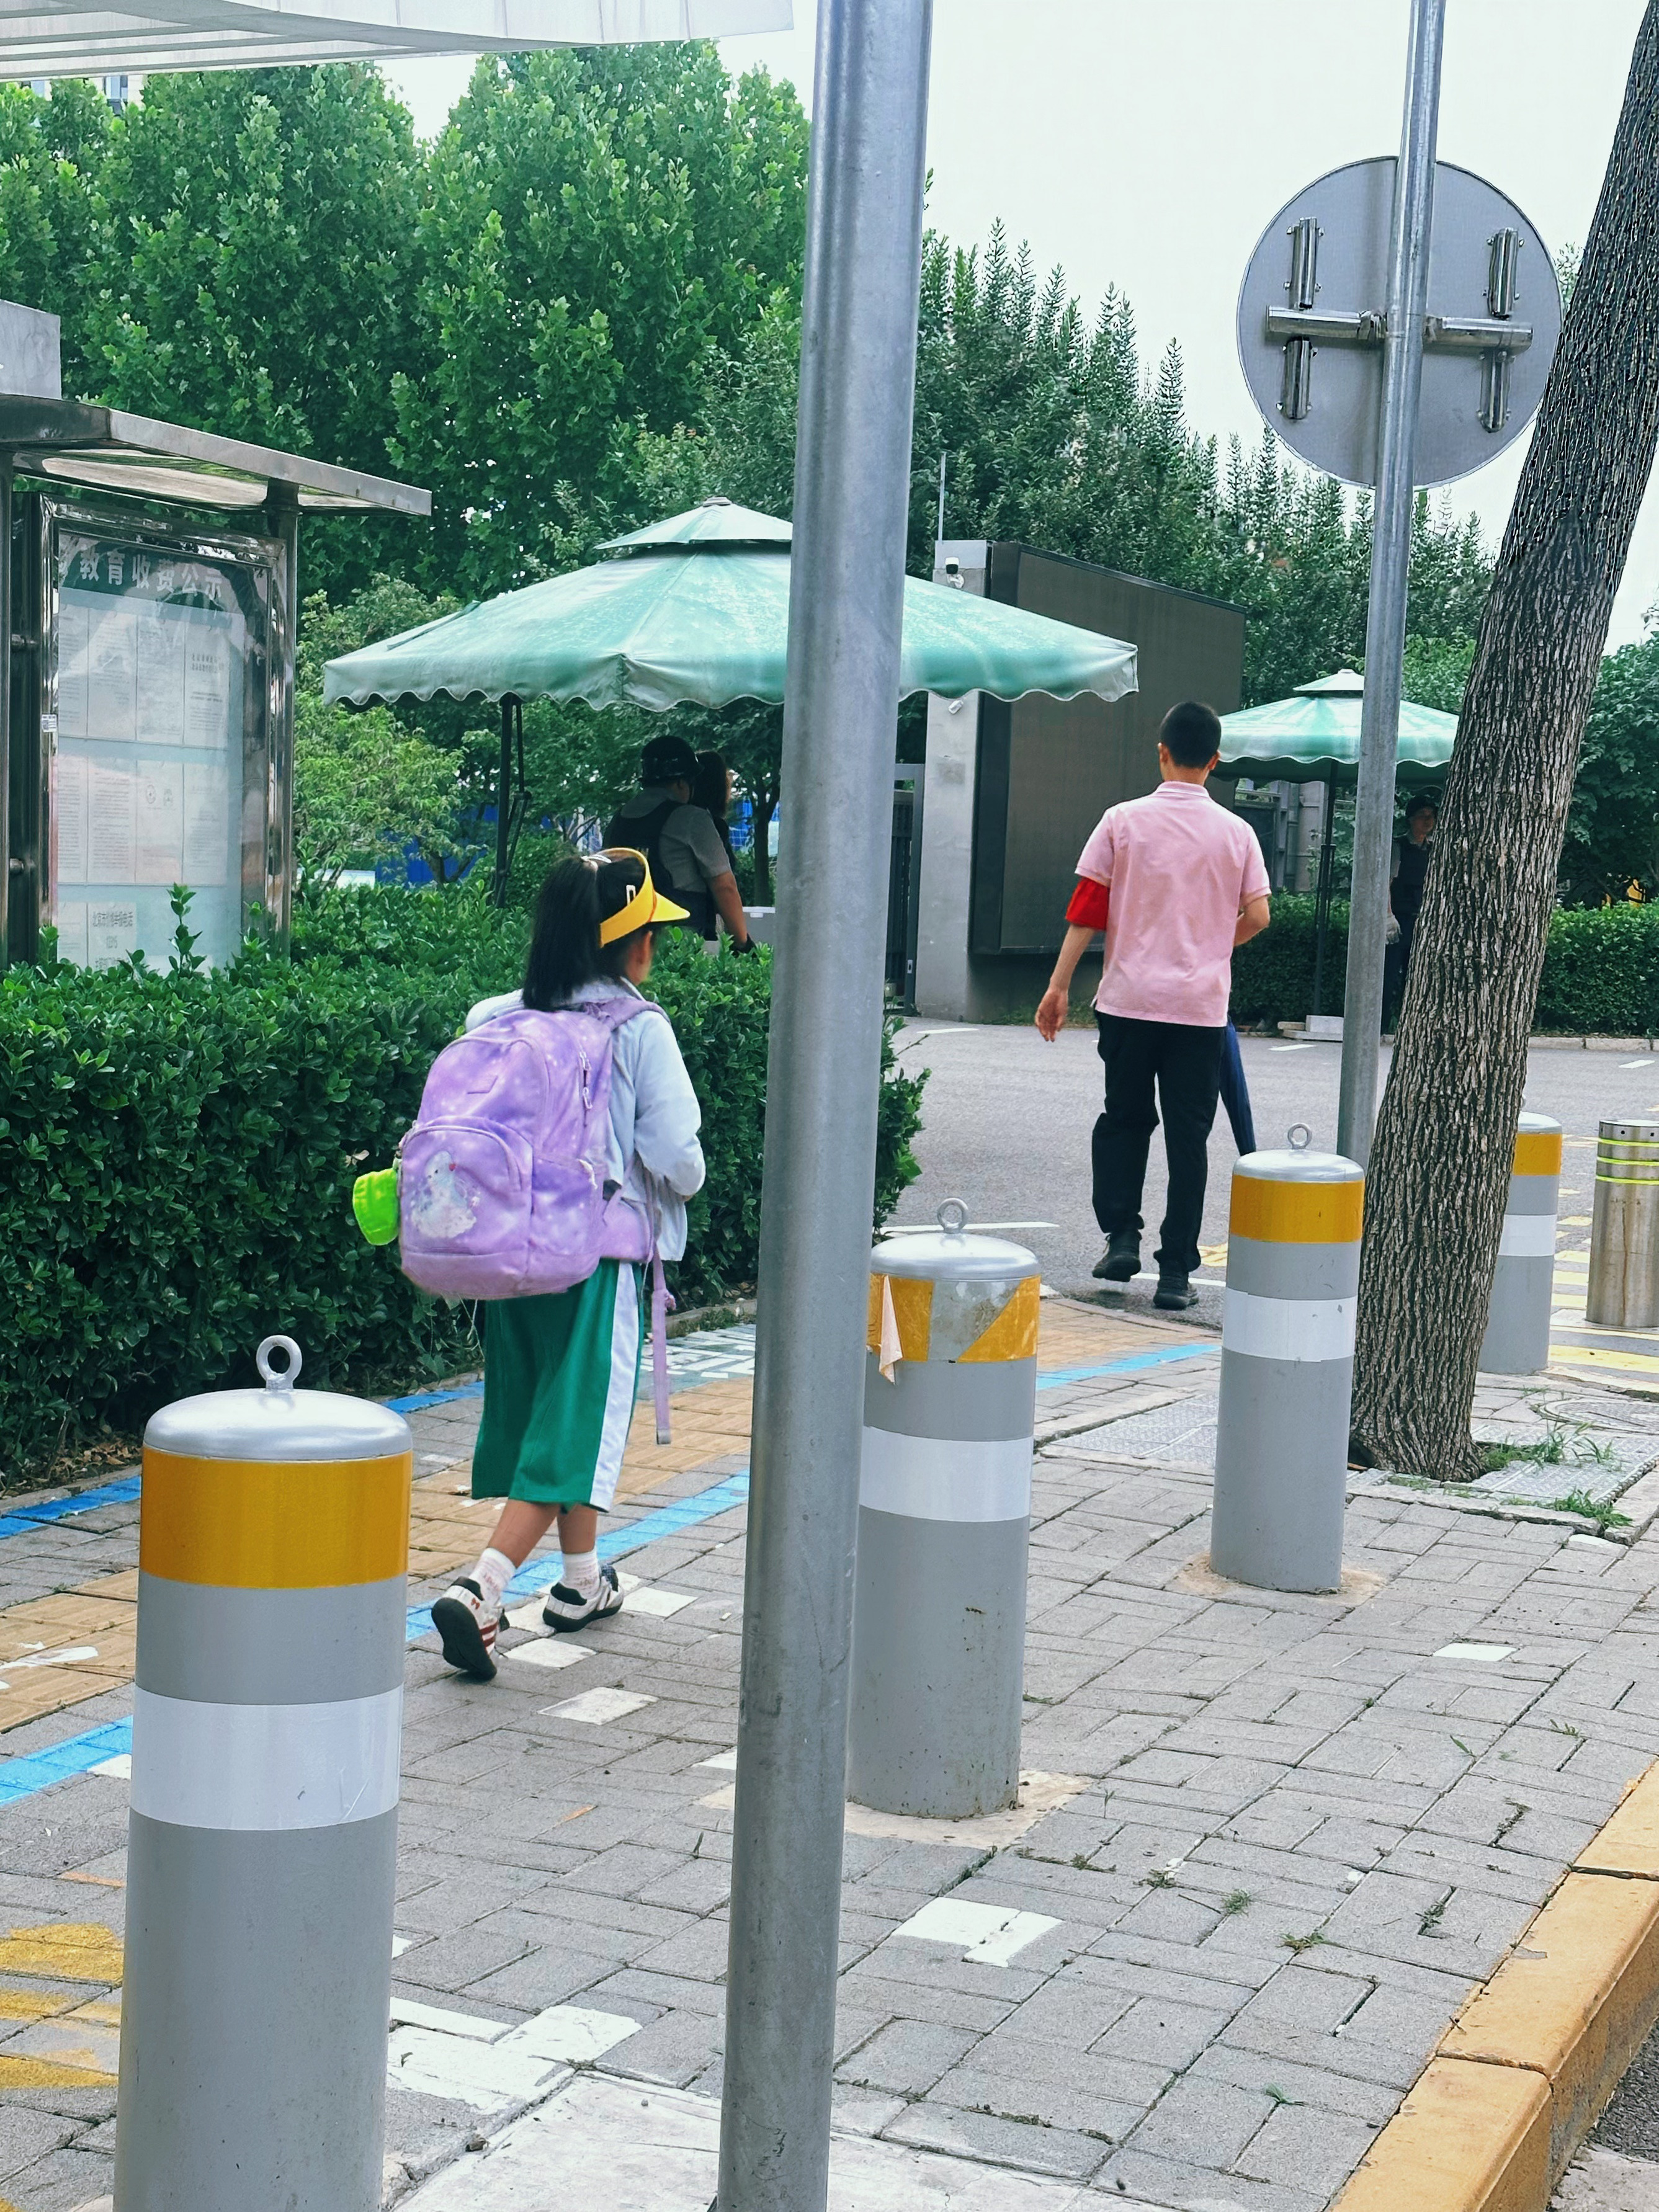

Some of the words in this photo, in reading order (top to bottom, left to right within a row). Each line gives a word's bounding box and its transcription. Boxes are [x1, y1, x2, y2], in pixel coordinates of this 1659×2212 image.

[80, 547, 222, 600] 教育收费公示
